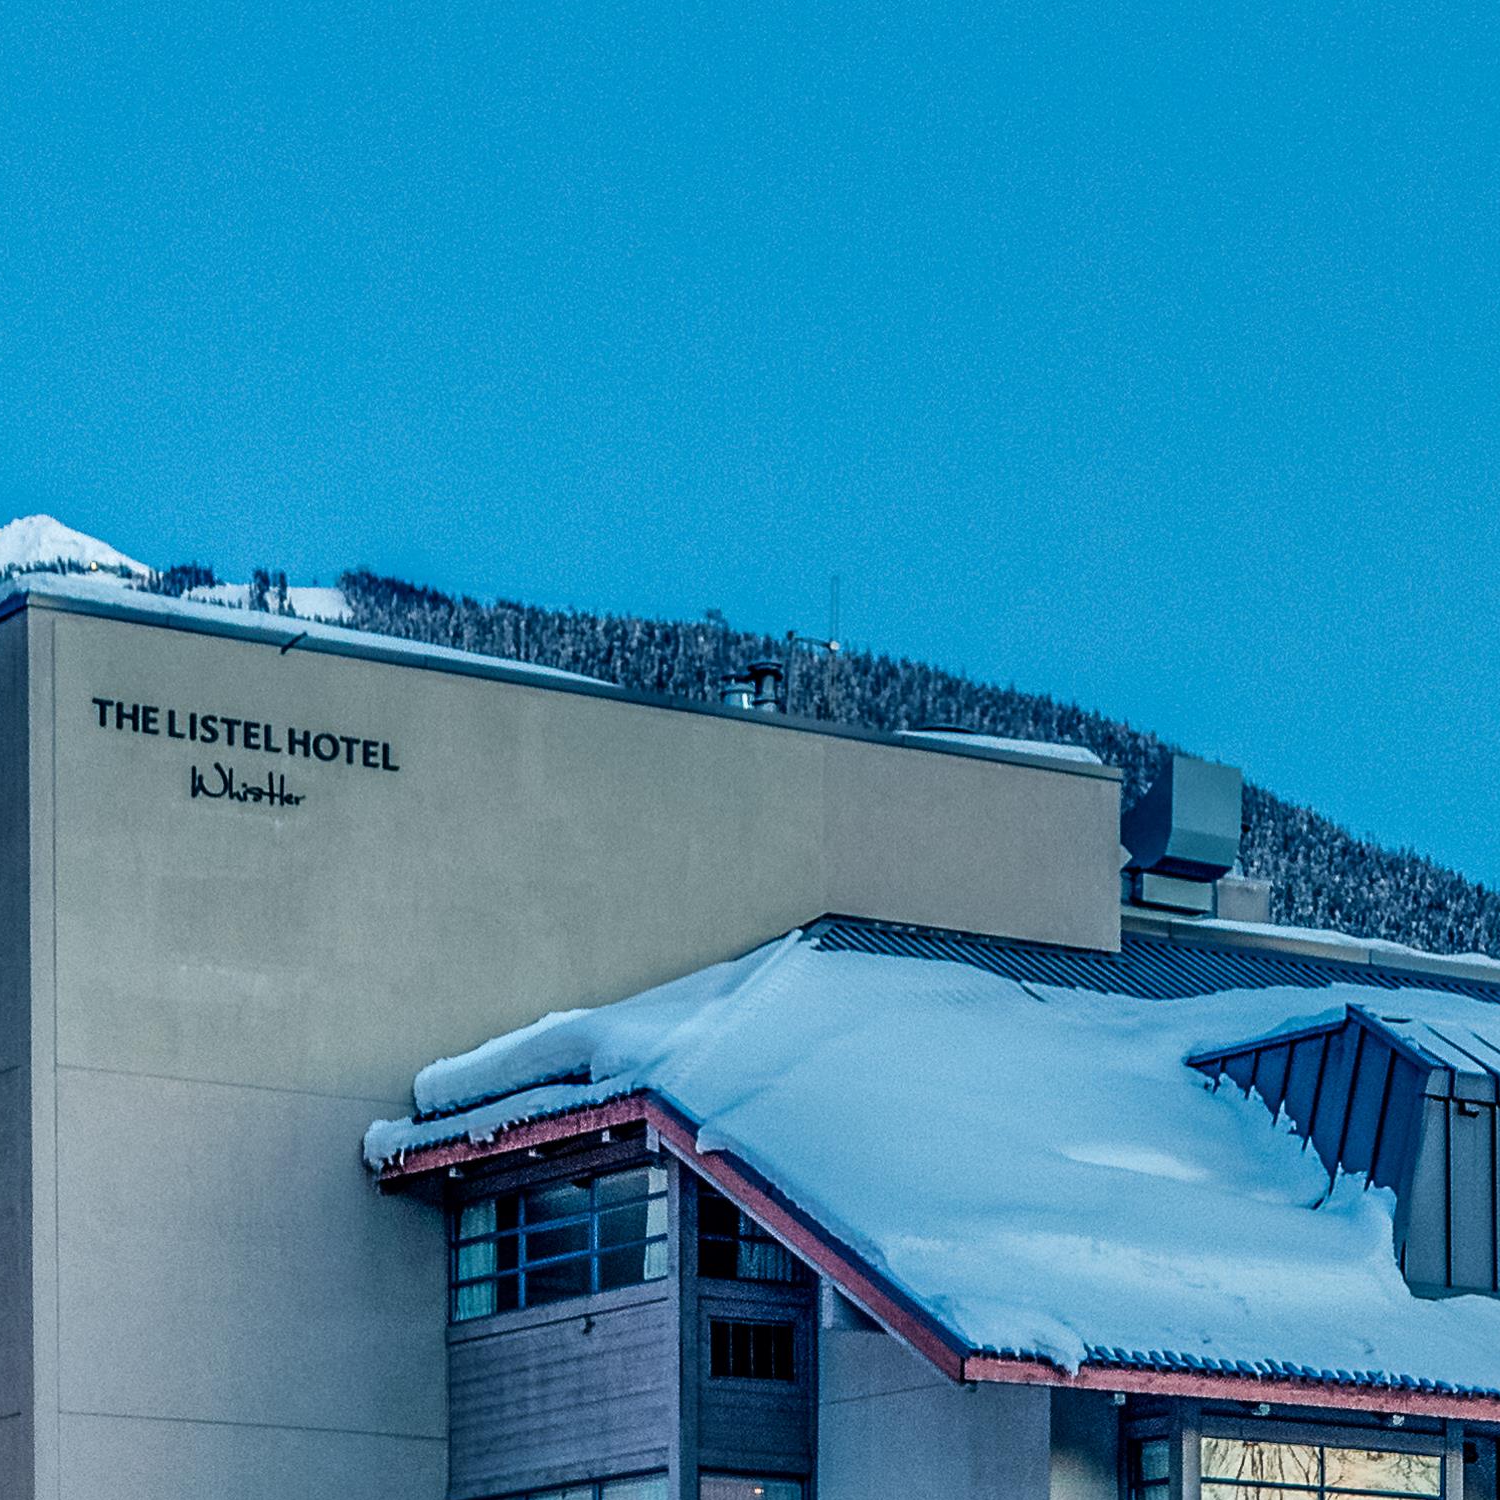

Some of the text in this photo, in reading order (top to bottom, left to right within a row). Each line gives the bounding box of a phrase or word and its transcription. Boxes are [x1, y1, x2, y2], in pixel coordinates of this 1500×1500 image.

[91, 697, 400, 771] THE LISTEL HOTEL
[191, 762, 306, 806] Whistler
